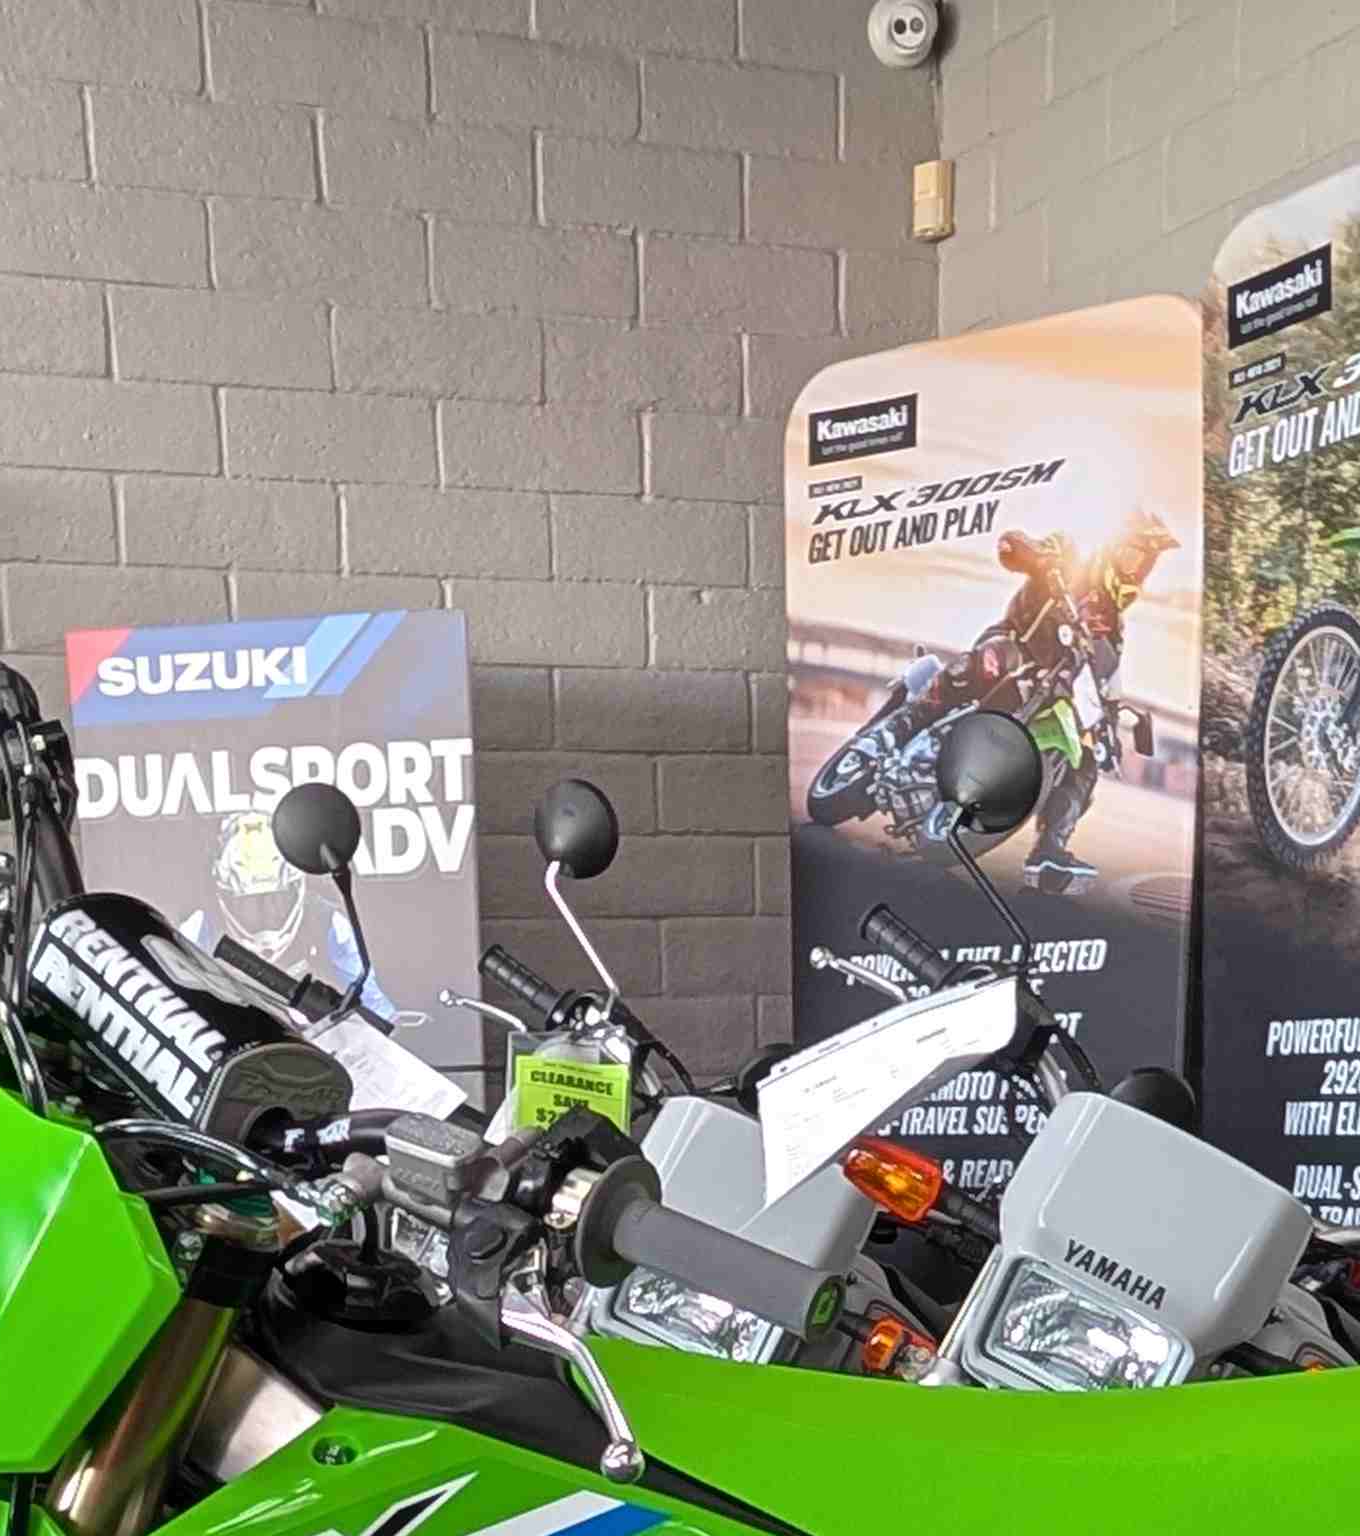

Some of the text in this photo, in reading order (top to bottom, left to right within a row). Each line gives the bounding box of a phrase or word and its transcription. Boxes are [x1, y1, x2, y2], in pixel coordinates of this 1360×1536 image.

[1235, 258, 1323, 320] Kawasaki
[816, 403, 909, 443] Kawasaki
[1231, 362, 1335, 424] KLX
[1228, 428, 1268, 479] GET
[1271, 407, 1320, 463] OUT
[812, 458, 1067, 526] KLX 300SM
[808, 499, 1000, 565] GET OUT AND PLAY
[96, 645, 308, 697] SUZUKI
[352, 804, 476, 876] DV
[48, 908, 226, 1073] RENTHAL
[31, 942, 198, 1119] RENTHAL
[529, 1069, 615, 1096] CLEARANCE
[1283, 1102, 1334, 1136] WITH
[1062, 1238, 1168, 1311] YAMAHA
